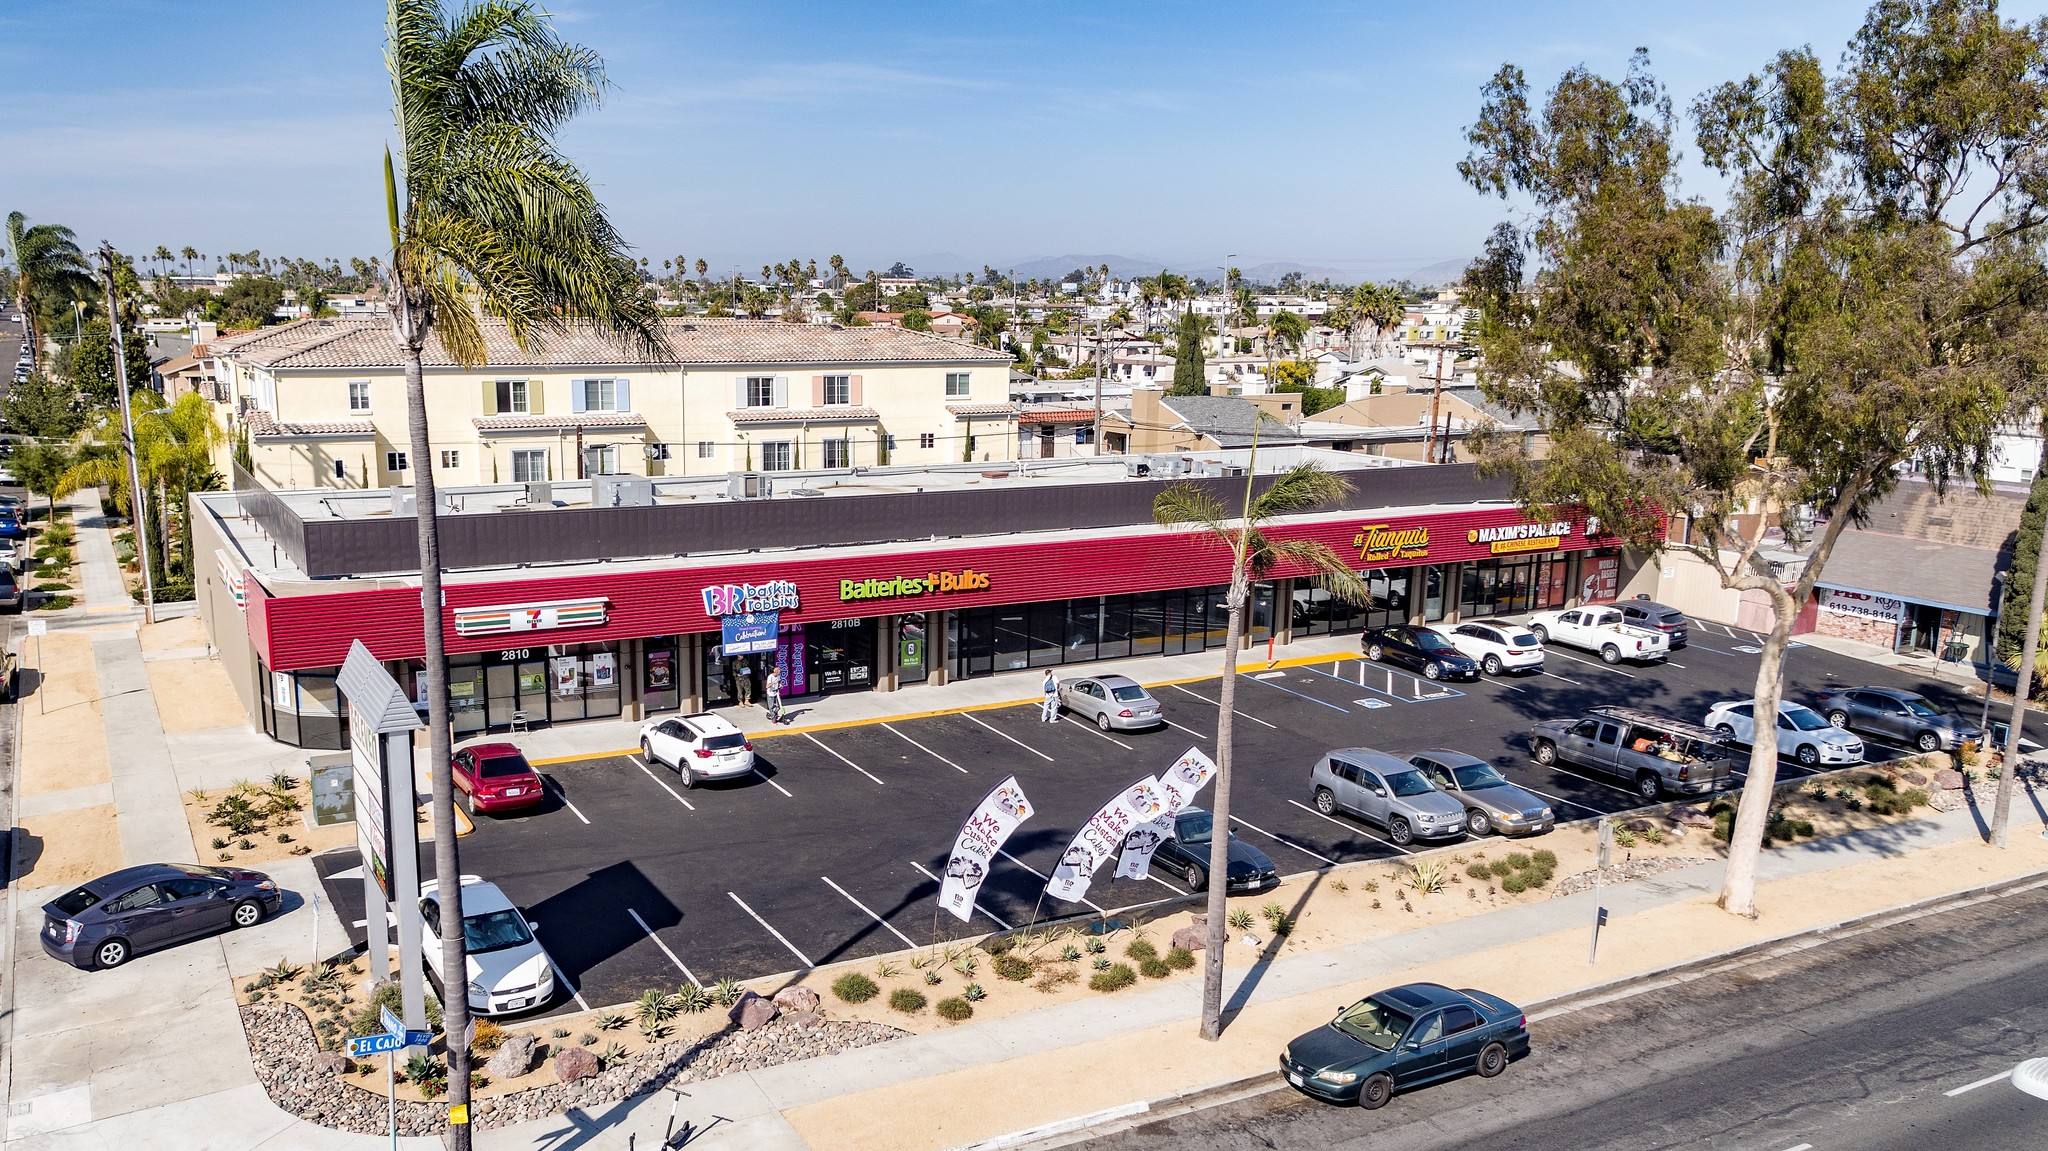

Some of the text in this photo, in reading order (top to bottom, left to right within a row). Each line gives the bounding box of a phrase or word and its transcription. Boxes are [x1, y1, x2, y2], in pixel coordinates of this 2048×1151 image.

[1360, 524, 1429, 560] Tianguis
[1479, 524, 1528, 542] MAXIM'S
[1366, 551, 1389, 562] Rolled
[746, 581, 797, 600] baskin
[747, 594, 799, 613] robbins
[1829, 602, 1898, 621] 619-738-8184
[831, 618, 861, 630] 2810B
[501, 649, 530, 661] 2810
[982, 812, 1001, 834] We
[1098, 809, 1125, 837] Make
[1113, 806, 1129, 826] We
[1151, 815, 1172, 831] akes
[969, 816, 998, 848] Make
[1089, 816, 1118, 848] Custom
[1083, 828, 1108, 857] Cakes
[360, 1036, 402, 1053] EL CAJO
